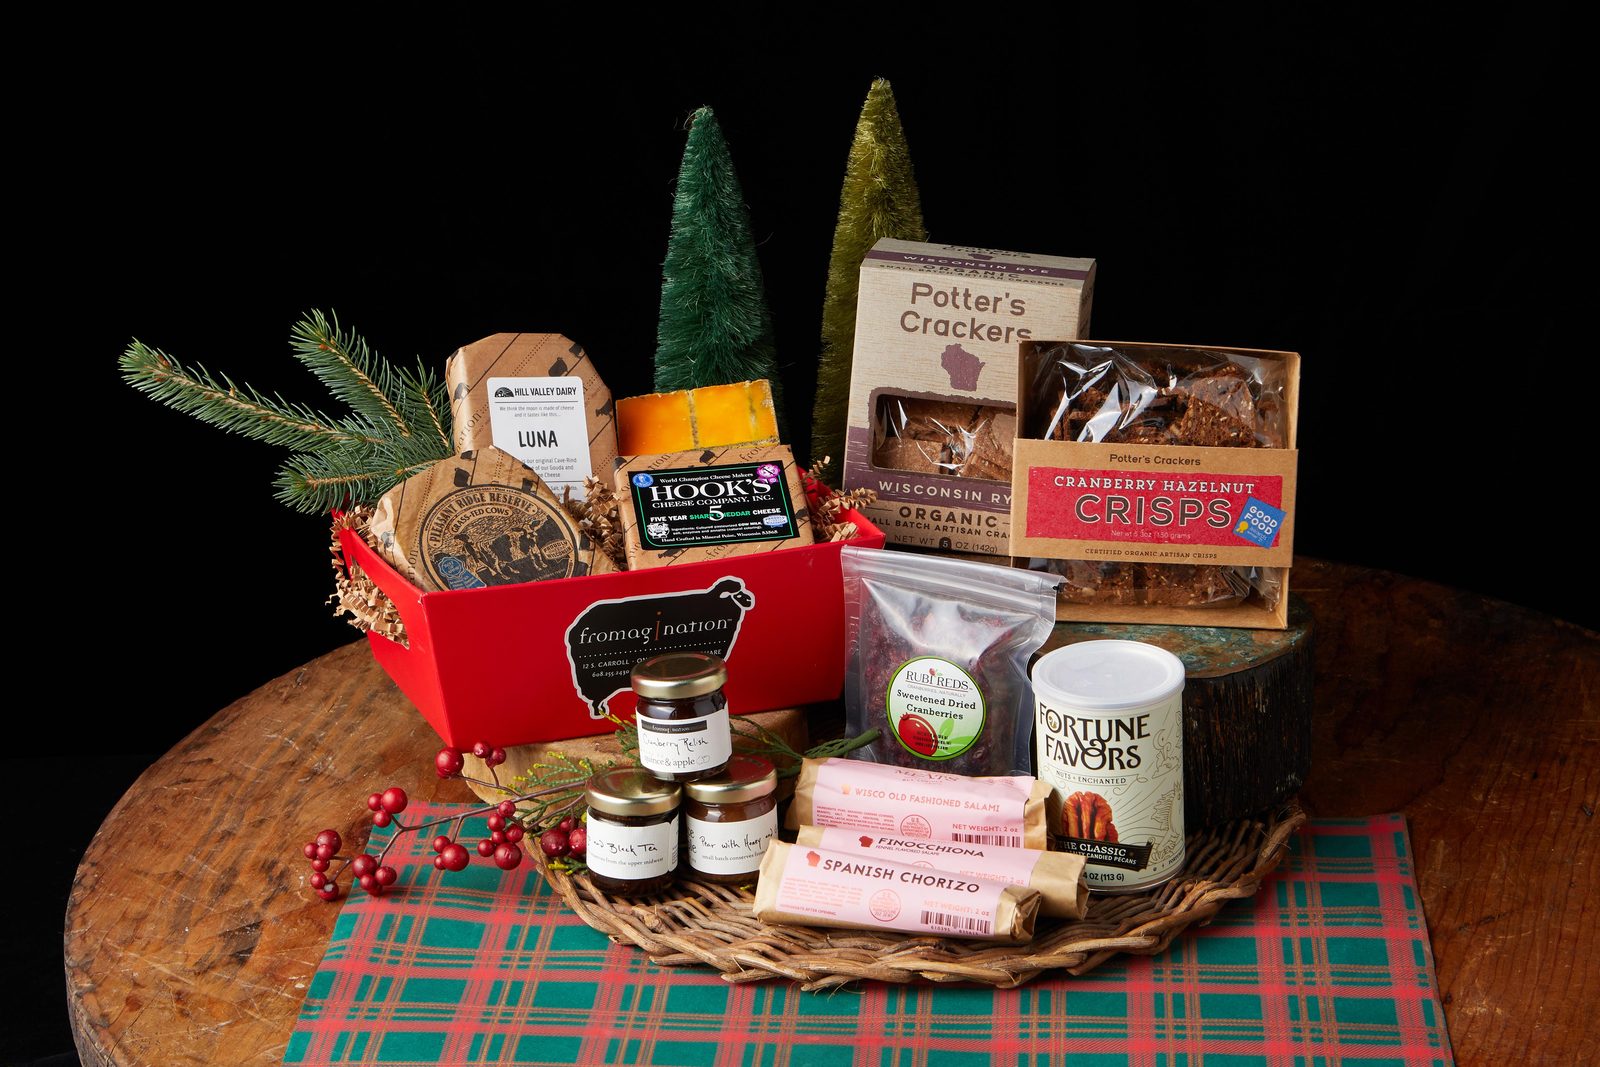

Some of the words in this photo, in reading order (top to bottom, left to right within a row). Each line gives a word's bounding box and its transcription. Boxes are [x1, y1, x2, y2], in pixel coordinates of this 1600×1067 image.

[903, 255, 1007, 270] WISCONSIN
[879, 264, 913, 272] SMALL
[1008, 278, 1065, 287] CRACKERS
[923, 265, 1020, 279] ORGANIC
[910, 282, 1026, 317] Potter's
[900, 310, 1032, 343] Crackers
[514, 388, 529, 396] HILL
[530, 387, 555, 396] VALLEY
[556, 387, 577, 396] DAIRY
[518, 430, 558, 448] LUNA
[535, 458, 554, 466] original
[1110, 453, 1151, 465] Potter's
[1154, 455, 1201, 466] Crackers
[679, 476, 709, 484] Champion
[1054, 475, 1155, 492] CRANBERRY
[1162, 480, 1255, 494] HAZELNUT
[649, 478, 772, 502] HOOK'S
[878, 480, 982, 502] WISCONSIN
[652, 500, 696, 510] CHEESE
[696, 496, 750, 506] COMPANY,
[752, 494, 774, 502] INC.
[429, 503, 458, 543] PLEASANT
[457, 492, 487, 508] RIDGE
[488, 492, 535, 514] RESERVE
[708, 504, 724, 522] 5
[752, 508, 782, 516] CHEESE
[900, 506, 998, 528] ORGANIC
[1074, 493, 1232, 529] CRISPS
[1250, 506, 1278, 528] GOOD
[451, 507, 485, 534] GRASS-FED
[486, 506, 510, 516] COWS
[895, 520, 930, 530] BATCH
[934, 524, 982, 536] ARTISAN
[1244, 512, 1272, 535] FOOD
[894, 534, 914, 544] NET
[919, 537, 935, 546] WT
[942, 540, 949, 548] 5
[955, 542, 969, 550] OZ
[972, 542, 998, 554] (142g)
[1170, 532, 1191, 540] grams
[1084, 548, 1123, 556] CERTIFIED
[598, 658, 630, 668] CARROLL
[905, 670, 934, 686] RUBI
[936, 676, 969, 690] REDS
[896, 688, 946, 706] Sweetened
[948, 698, 976, 710] Dried
[906, 703, 964, 720] Cranberries
[1040, 702, 1151, 744] FORTUNE
[1046, 734, 1142, 771] FAVORS
[1056, 770, 1072, 780] NUTS
[1078, 776, 1127, 785] ENCHANTED
[854, 788, 888, 800] WISCO
[888, 791, 908, 801] OLD
[909, 794, 962, 808] FASHIONED
[964, 801, 1000, 813] SALAMI
[952, 823, 967, 831] NET
[637, 843, 658, 852] Tea
[698, 835, 716, 848] Pear
[721, 839, 740, 850] with
[878, 837, 985, 858] FINOCCHIONA
[899, 846, 922, 854] FLAVORED
[1080, 843, 1127, 857] CLASSIC
[606, 856, 618, 864] from
[643, 857, 664, 865] midwest
[1086, 853, 1113, 862] CANDIED
[1113, 856, 1137, 866] PECANS
[823, 858, 895, 881] SPANISH
[900, 870, 980, 894] CHORIZO
[975, 872, 1008, 882] WEIGHT:
[1089, 872, 1100, 880] OZ
[1100, 873, 1116, 882] (113
[1116, 873, 1125, 882] G)
[924, 900, 938, 908] NET
[940, 902, 973, 913] WEIGHT:
